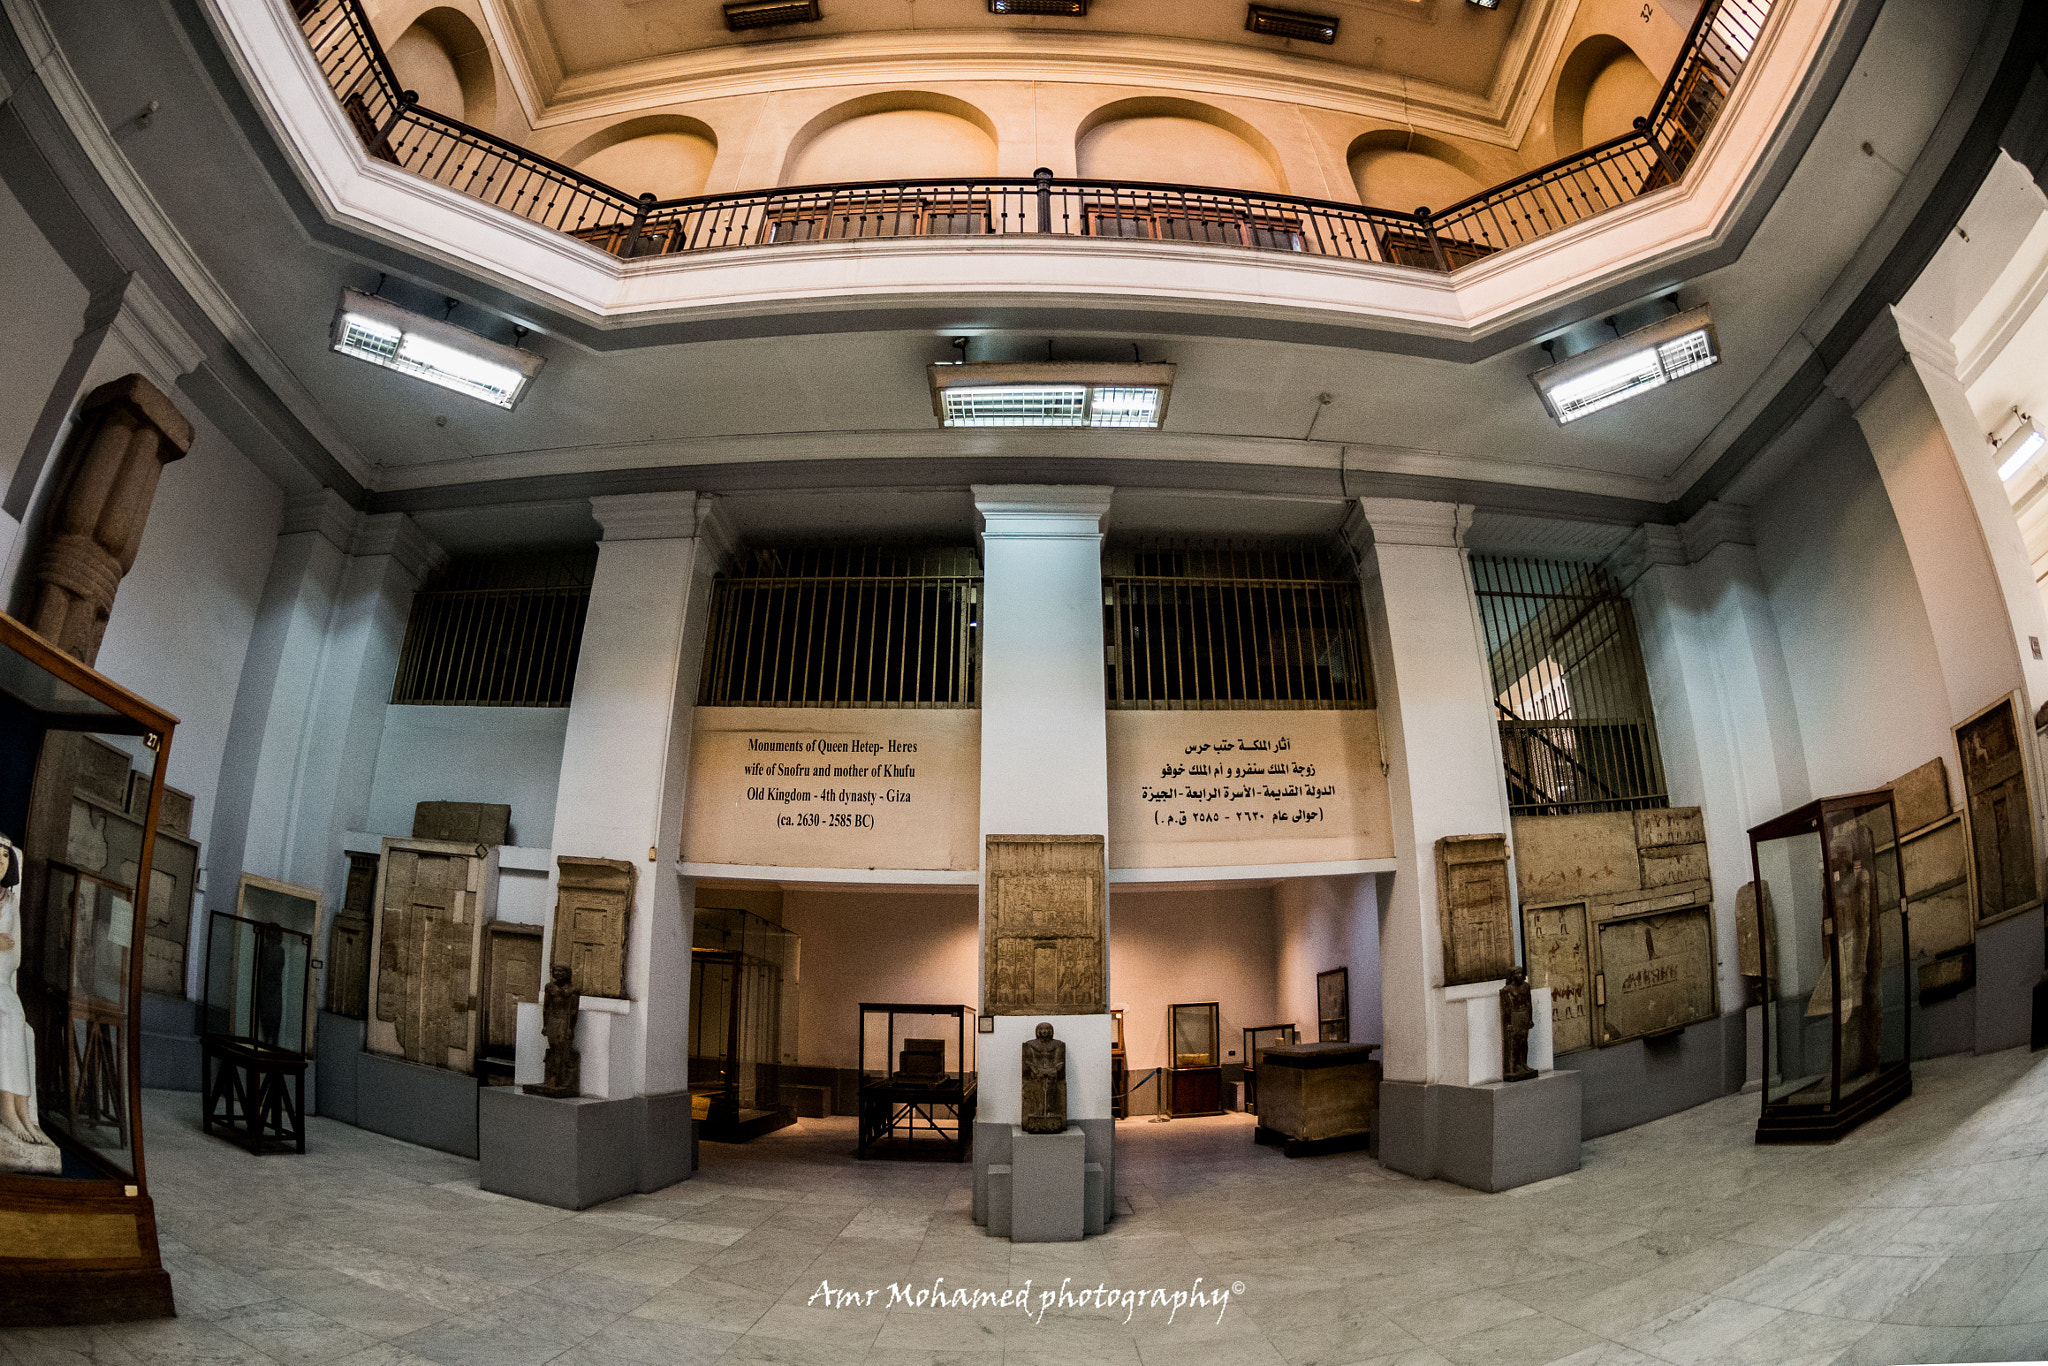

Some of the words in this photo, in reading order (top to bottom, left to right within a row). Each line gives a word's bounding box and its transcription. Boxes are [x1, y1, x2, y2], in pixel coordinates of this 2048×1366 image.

[1640, 3, 1653, 23] 32
[146, 732, 158, 748] 27
[747, 738, 804, 752] Monuments
[805, 739, 818, 752] of
[818, 739, 849, 756] Queen
[851, 740, 884, 757] Hetep-
[887, 739, 918, 753] Heres
[1213, 739, 1235, 755] حتب
[1184, 743, 1211, 755] حرس
[744, 762, 764, 776] wife
[765, 763, 778, 776] of
[777, 763, 810, 777] Snofru
[812, 763, 831, 777] and
[833, 764, 869, 778] mother
[870, 764, 883, 778] of
[883, 764, 915, 778] Khufu
[1160, 763, 1186, 779] خوفو
[1188, 764, 1212, 776] الملك
[1235, 762, 1265, 779] سنفرو
[1267, 763, 1289, 776] الملك
[1291, 762, 1316, 778] زوجة
[746, 786, 765, 801] Old
[767, 788, 811, 805] Kingdom
[820, 789, 836, 802] 4th
[838, 789, 876, 806] dynasty
[886, 789, 911, 803] Giza
[1304, 784, 1336, 799] الدولة
[777, 813, 794, 829] (ca.
[796, 813, 820, 827] 2630
[828, 813, 852, 828] 2585
[854, 814, 875, 830] BC)
[1272, 810, 1289, 824] عام
